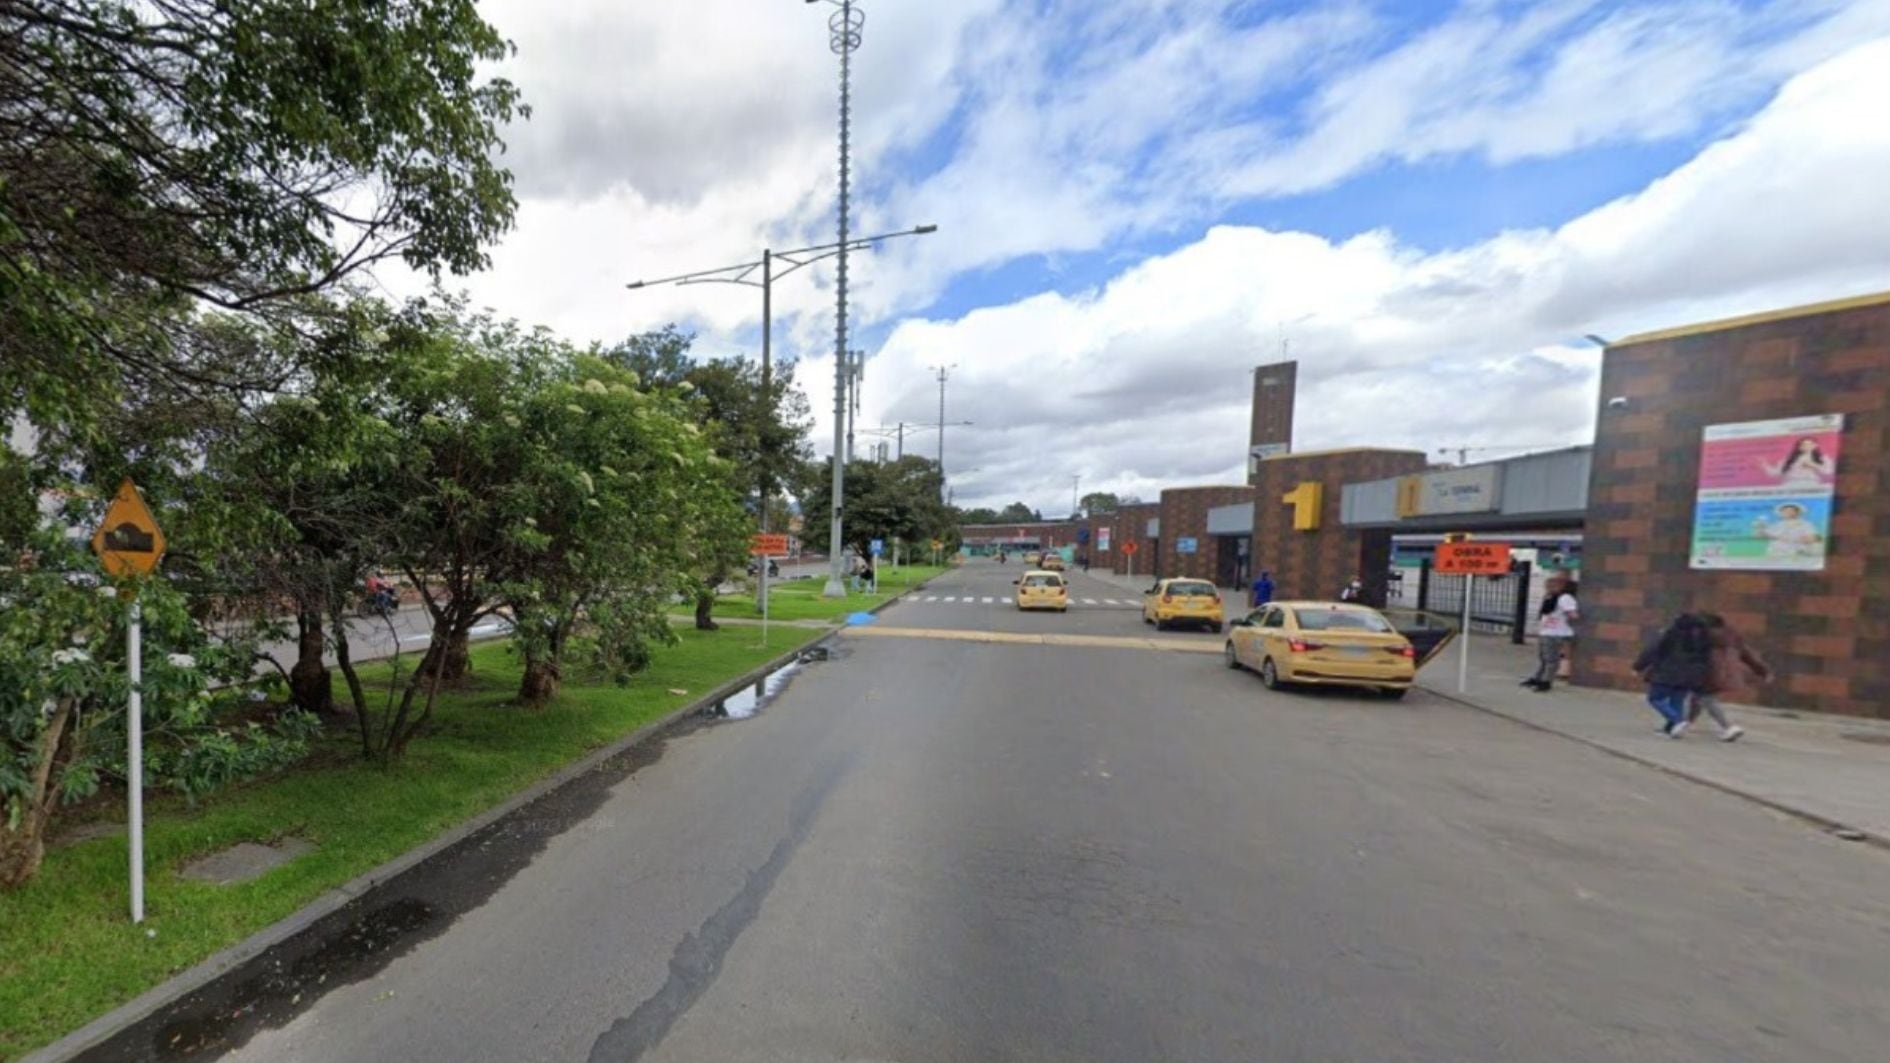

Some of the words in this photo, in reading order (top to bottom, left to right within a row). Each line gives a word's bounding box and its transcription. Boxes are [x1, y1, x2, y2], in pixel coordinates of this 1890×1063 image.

[1283, 482, 1322, 530] 1
[1453, 547, 1492, 557] OBRA
[1444, 559, 1454, 568] A
